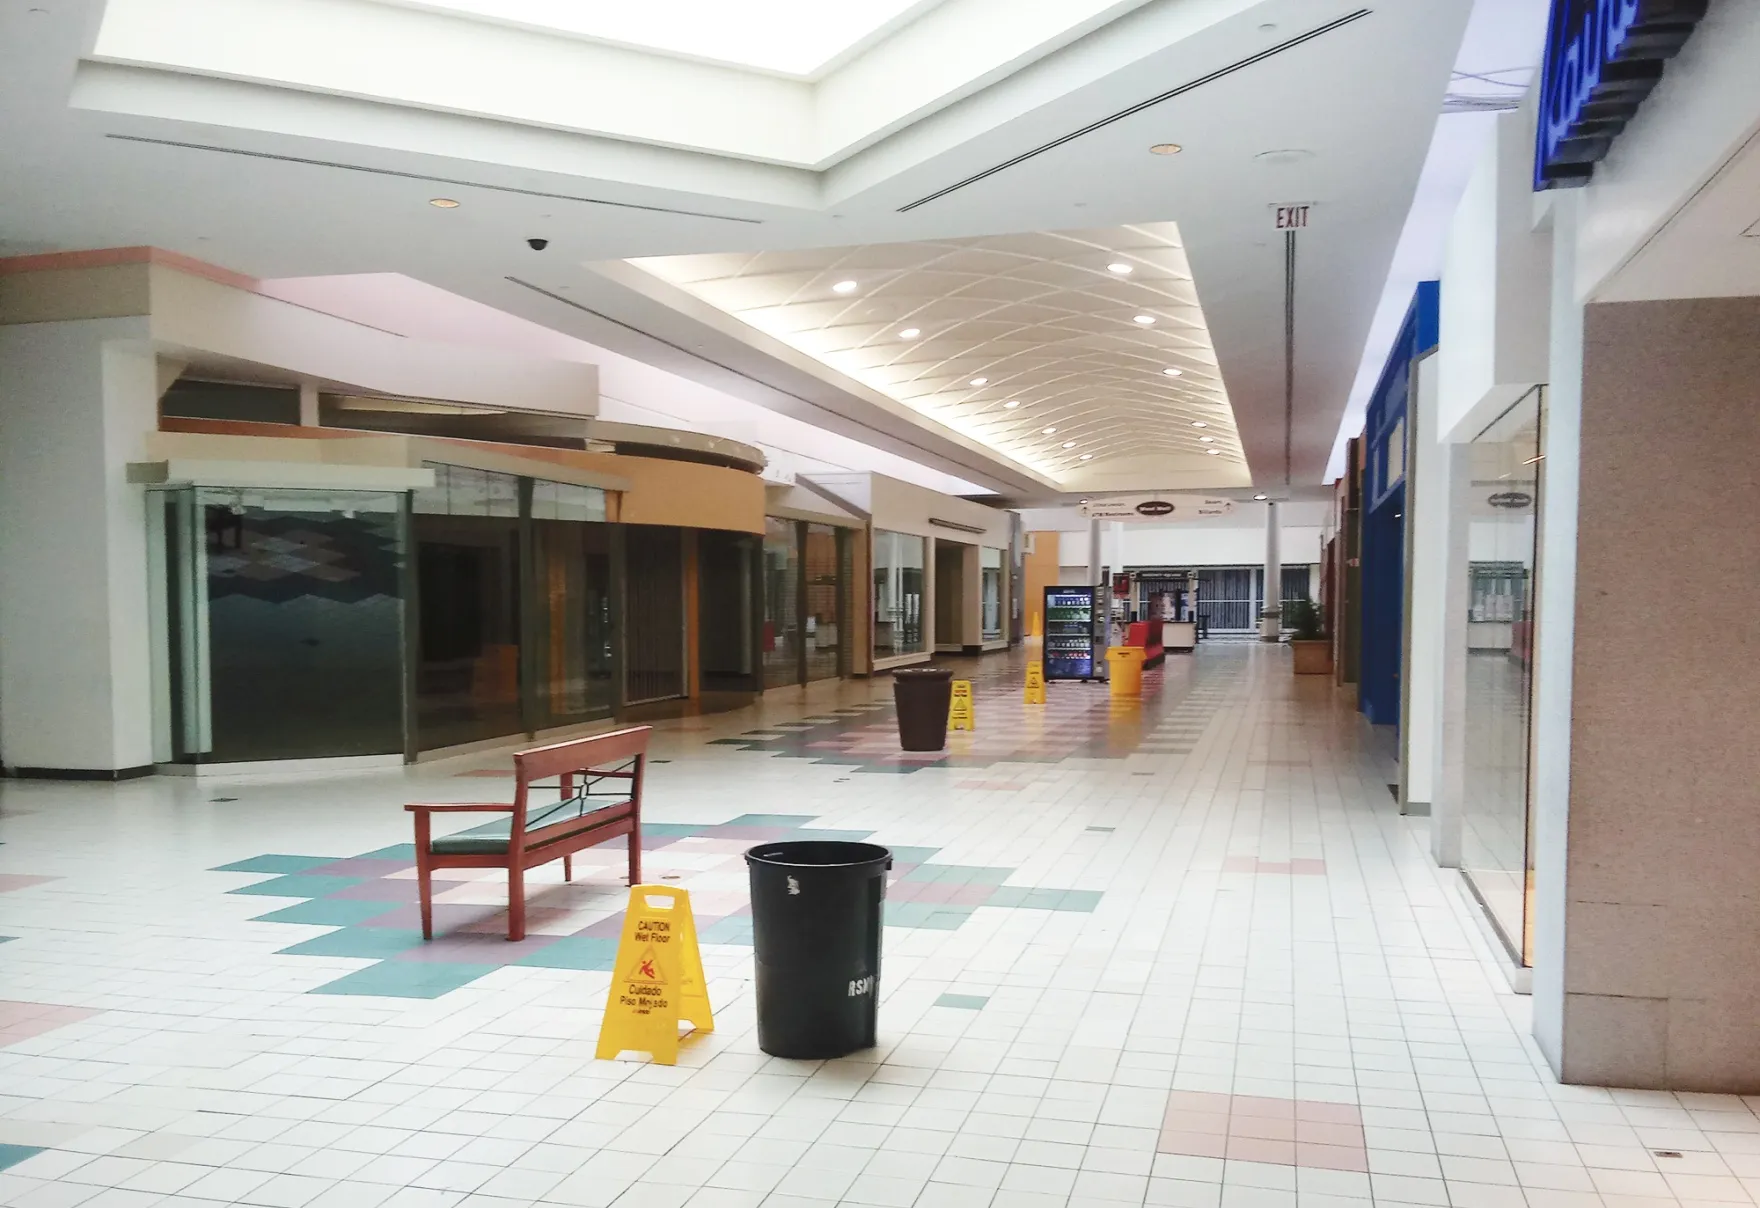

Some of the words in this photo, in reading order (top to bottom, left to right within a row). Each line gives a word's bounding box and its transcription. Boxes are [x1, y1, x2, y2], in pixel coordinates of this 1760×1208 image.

[1276, 206, 1309, 228] EXIT
[638, 921, 671, 932] CAUTION
[635, 932, 649, 942] Wet
[650, 932, 671, 943] Floor
[628, 984, 662, 996] Cuidado
[619, 996, 636, 1006] Piso
